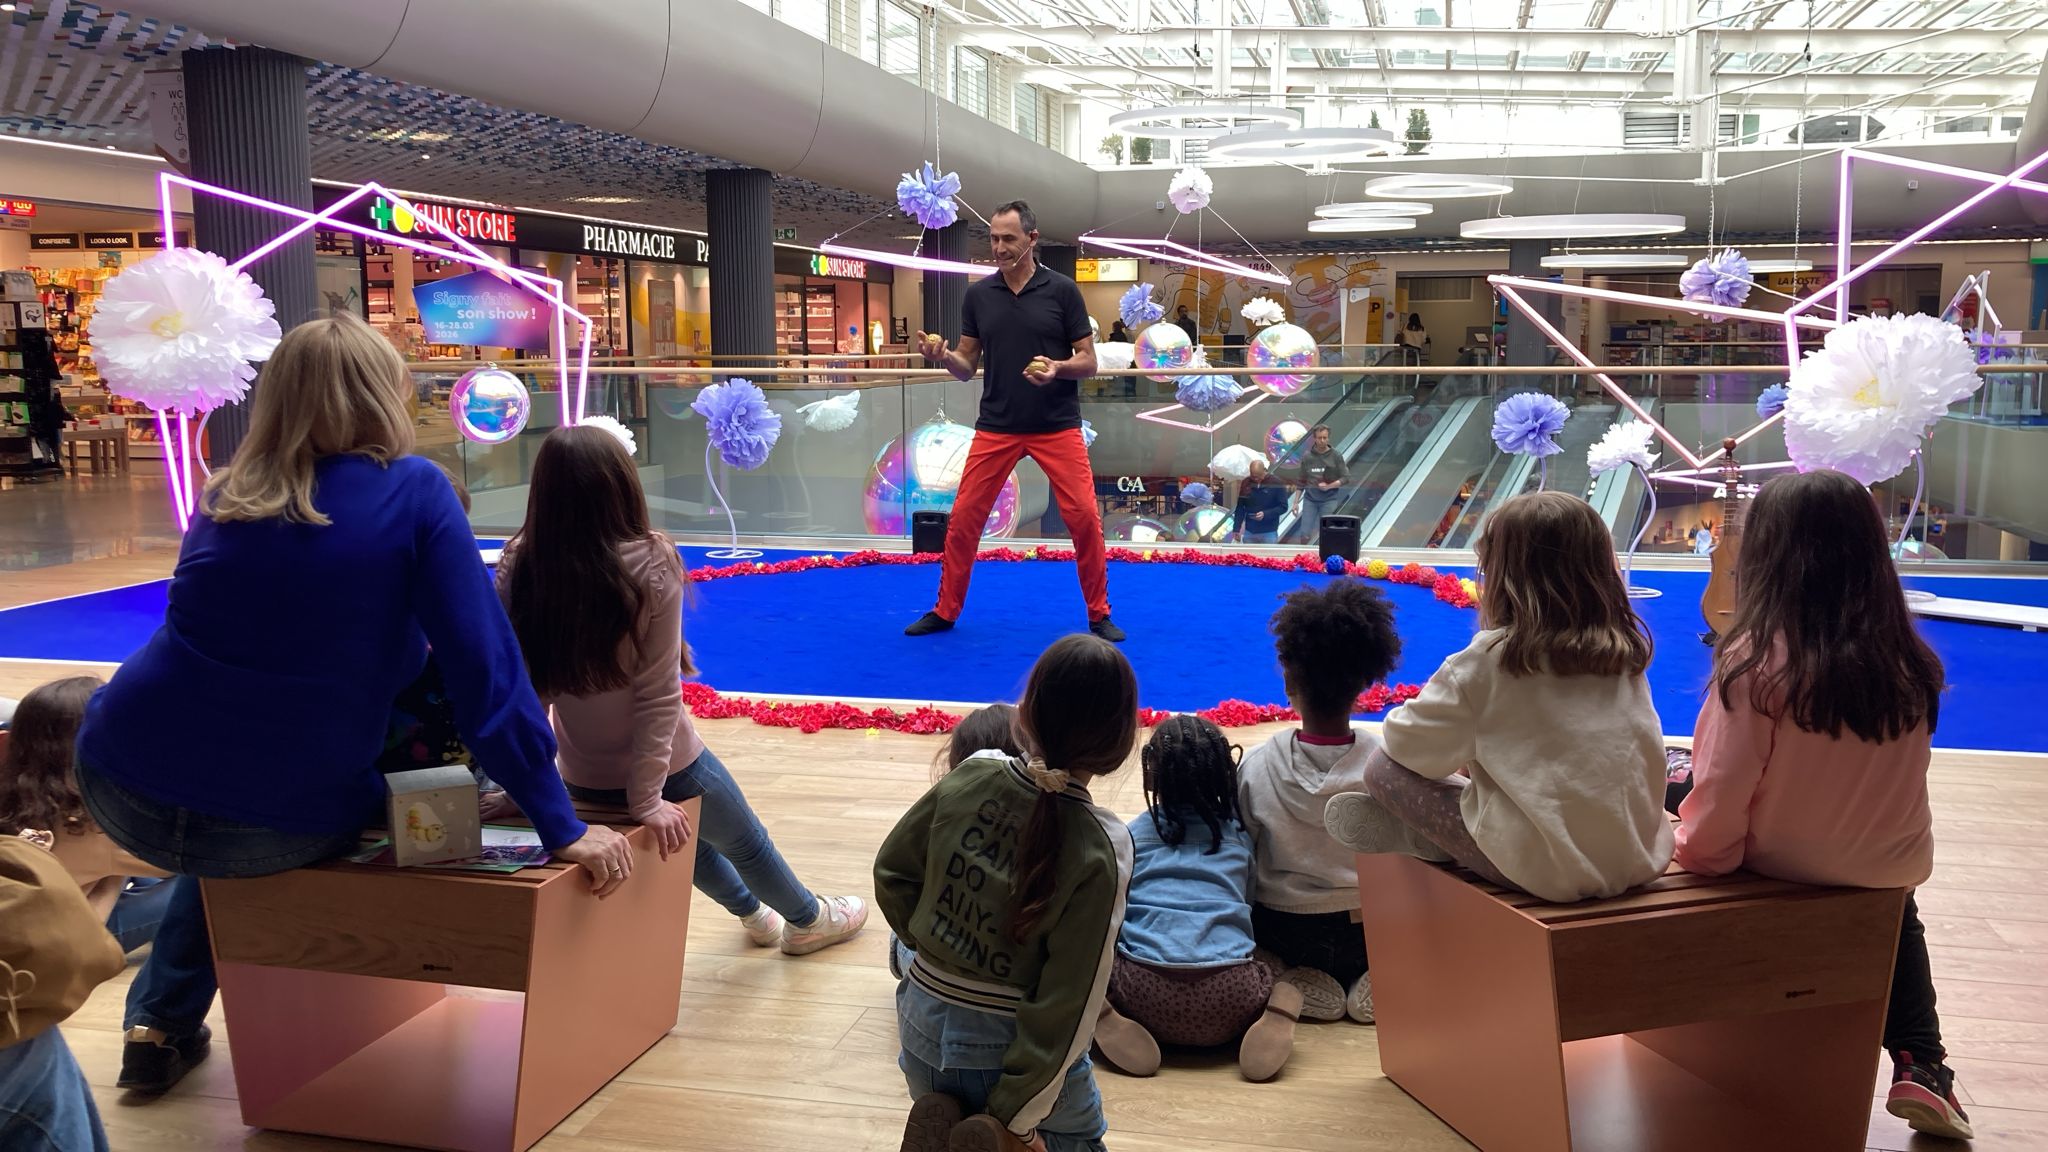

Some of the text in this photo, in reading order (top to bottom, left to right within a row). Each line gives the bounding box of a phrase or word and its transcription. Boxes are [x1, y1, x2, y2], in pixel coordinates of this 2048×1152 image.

[168, 89, 184, 99] WC
[413, 202, 517, 242] SUN STORE
[583, 224, 676, 259] PHARMACIE
[827, 257, 867, 278] SUN STORE
[1248, 262, 1272, 271] 1849
[1778, 277, 1789, 285] LA
[456, 309, 485, 320] son
[487, 306, 528, 320] show
[434, 321, 475, 330] 16-28.03
[434, 330, 460, 339] 2026
[1116, 475, 1146, 493] C&A
[945, 850, 987, 893] DO
[929, 909, 1013, 979] THING
